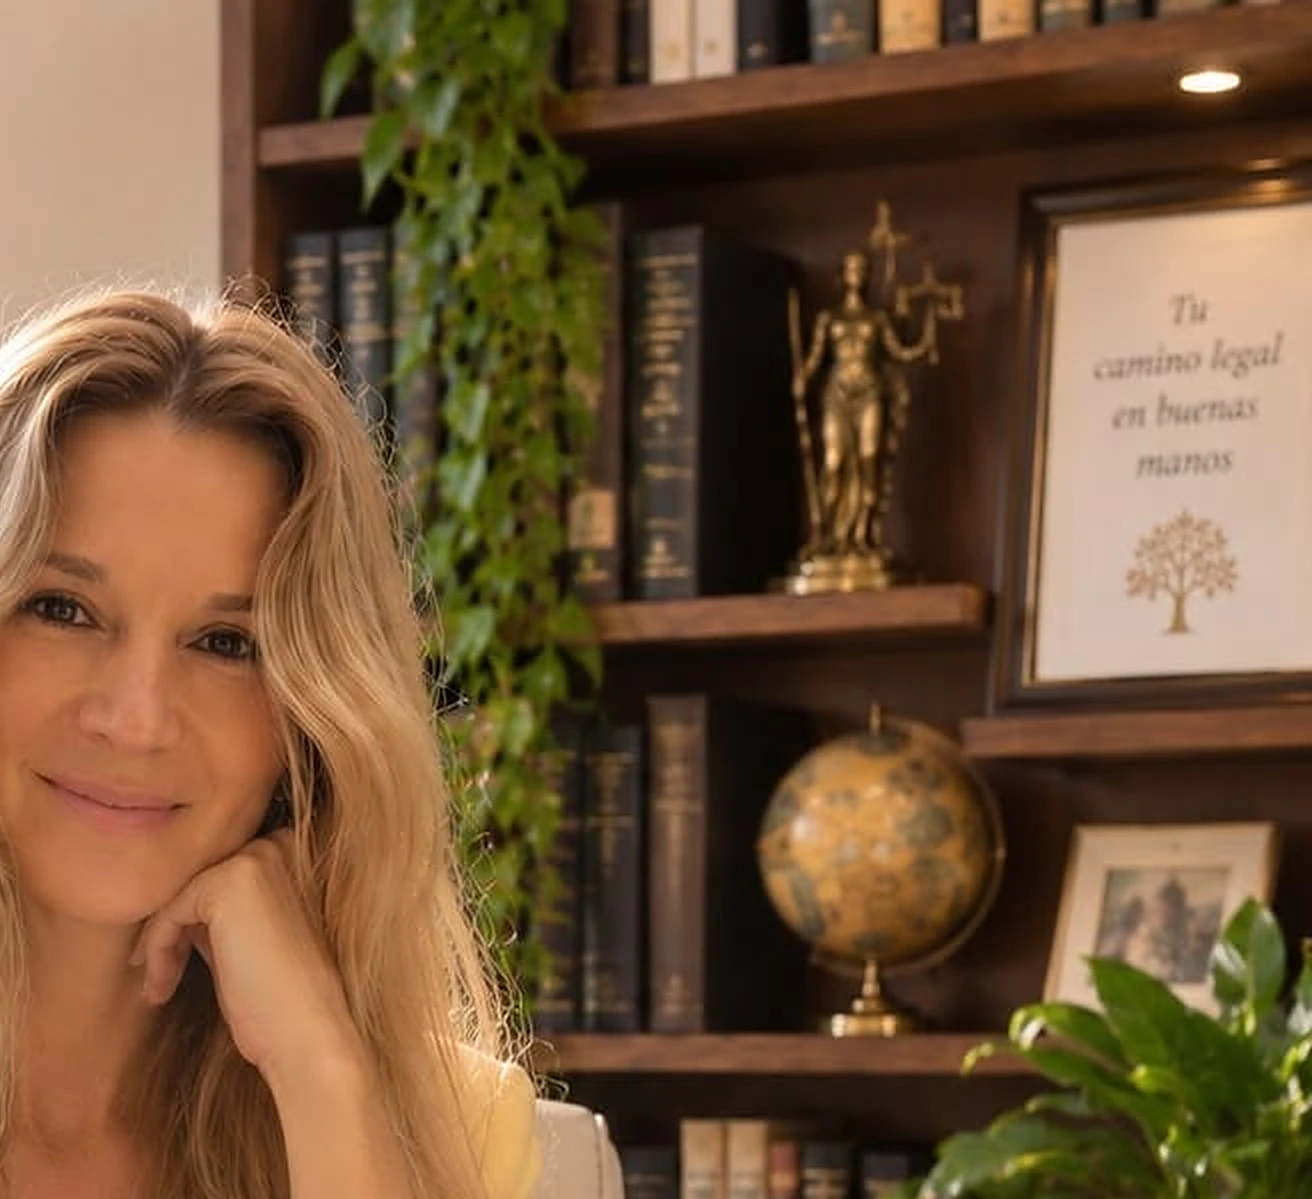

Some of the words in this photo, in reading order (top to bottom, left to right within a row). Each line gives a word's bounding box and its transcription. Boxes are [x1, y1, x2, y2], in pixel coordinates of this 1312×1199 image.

[1168, 294, 1208, 325] Tu
[1093, 342, 1202, 380] camino
[1211, 330, 1285, 379] legal
[1111, 405, 1148, 430] en
[1155, 393, 1258, 427] buenas
[1136, 450, 1235, 480] manos
